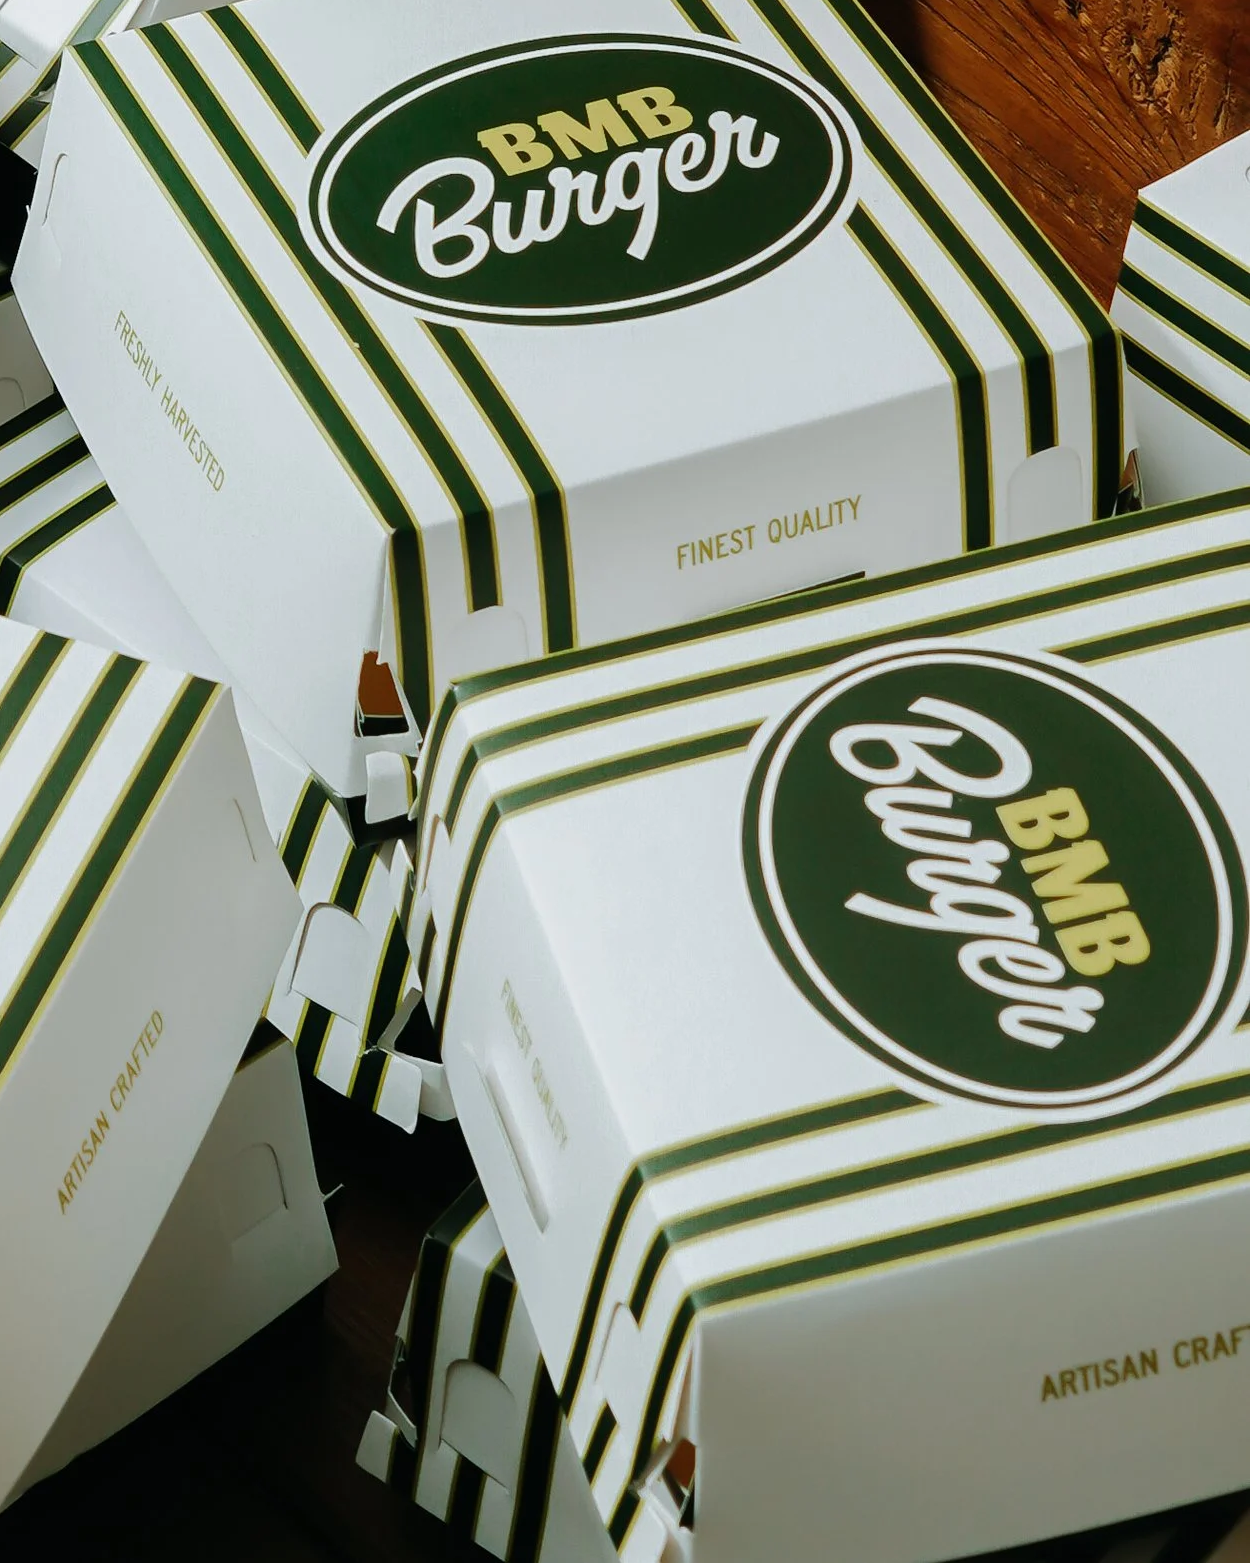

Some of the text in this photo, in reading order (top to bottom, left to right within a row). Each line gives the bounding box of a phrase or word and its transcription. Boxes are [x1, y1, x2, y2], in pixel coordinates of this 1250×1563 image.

[377, 109, 780, 280] Burger
[478, 86, 694, 177] BMB
[112, 309, 226, 493] FRESHLY HARVESTED
[676, 494, 863, 571] FINEST QUALITY
[828, 695, 1105, 1049] Burger
[996, 787, 1151, 977] BMB
[55, 1008, 165, 1216] ARTISAN CRAFTED
[1040, 1347, 1160, 1403] ARTISAN
